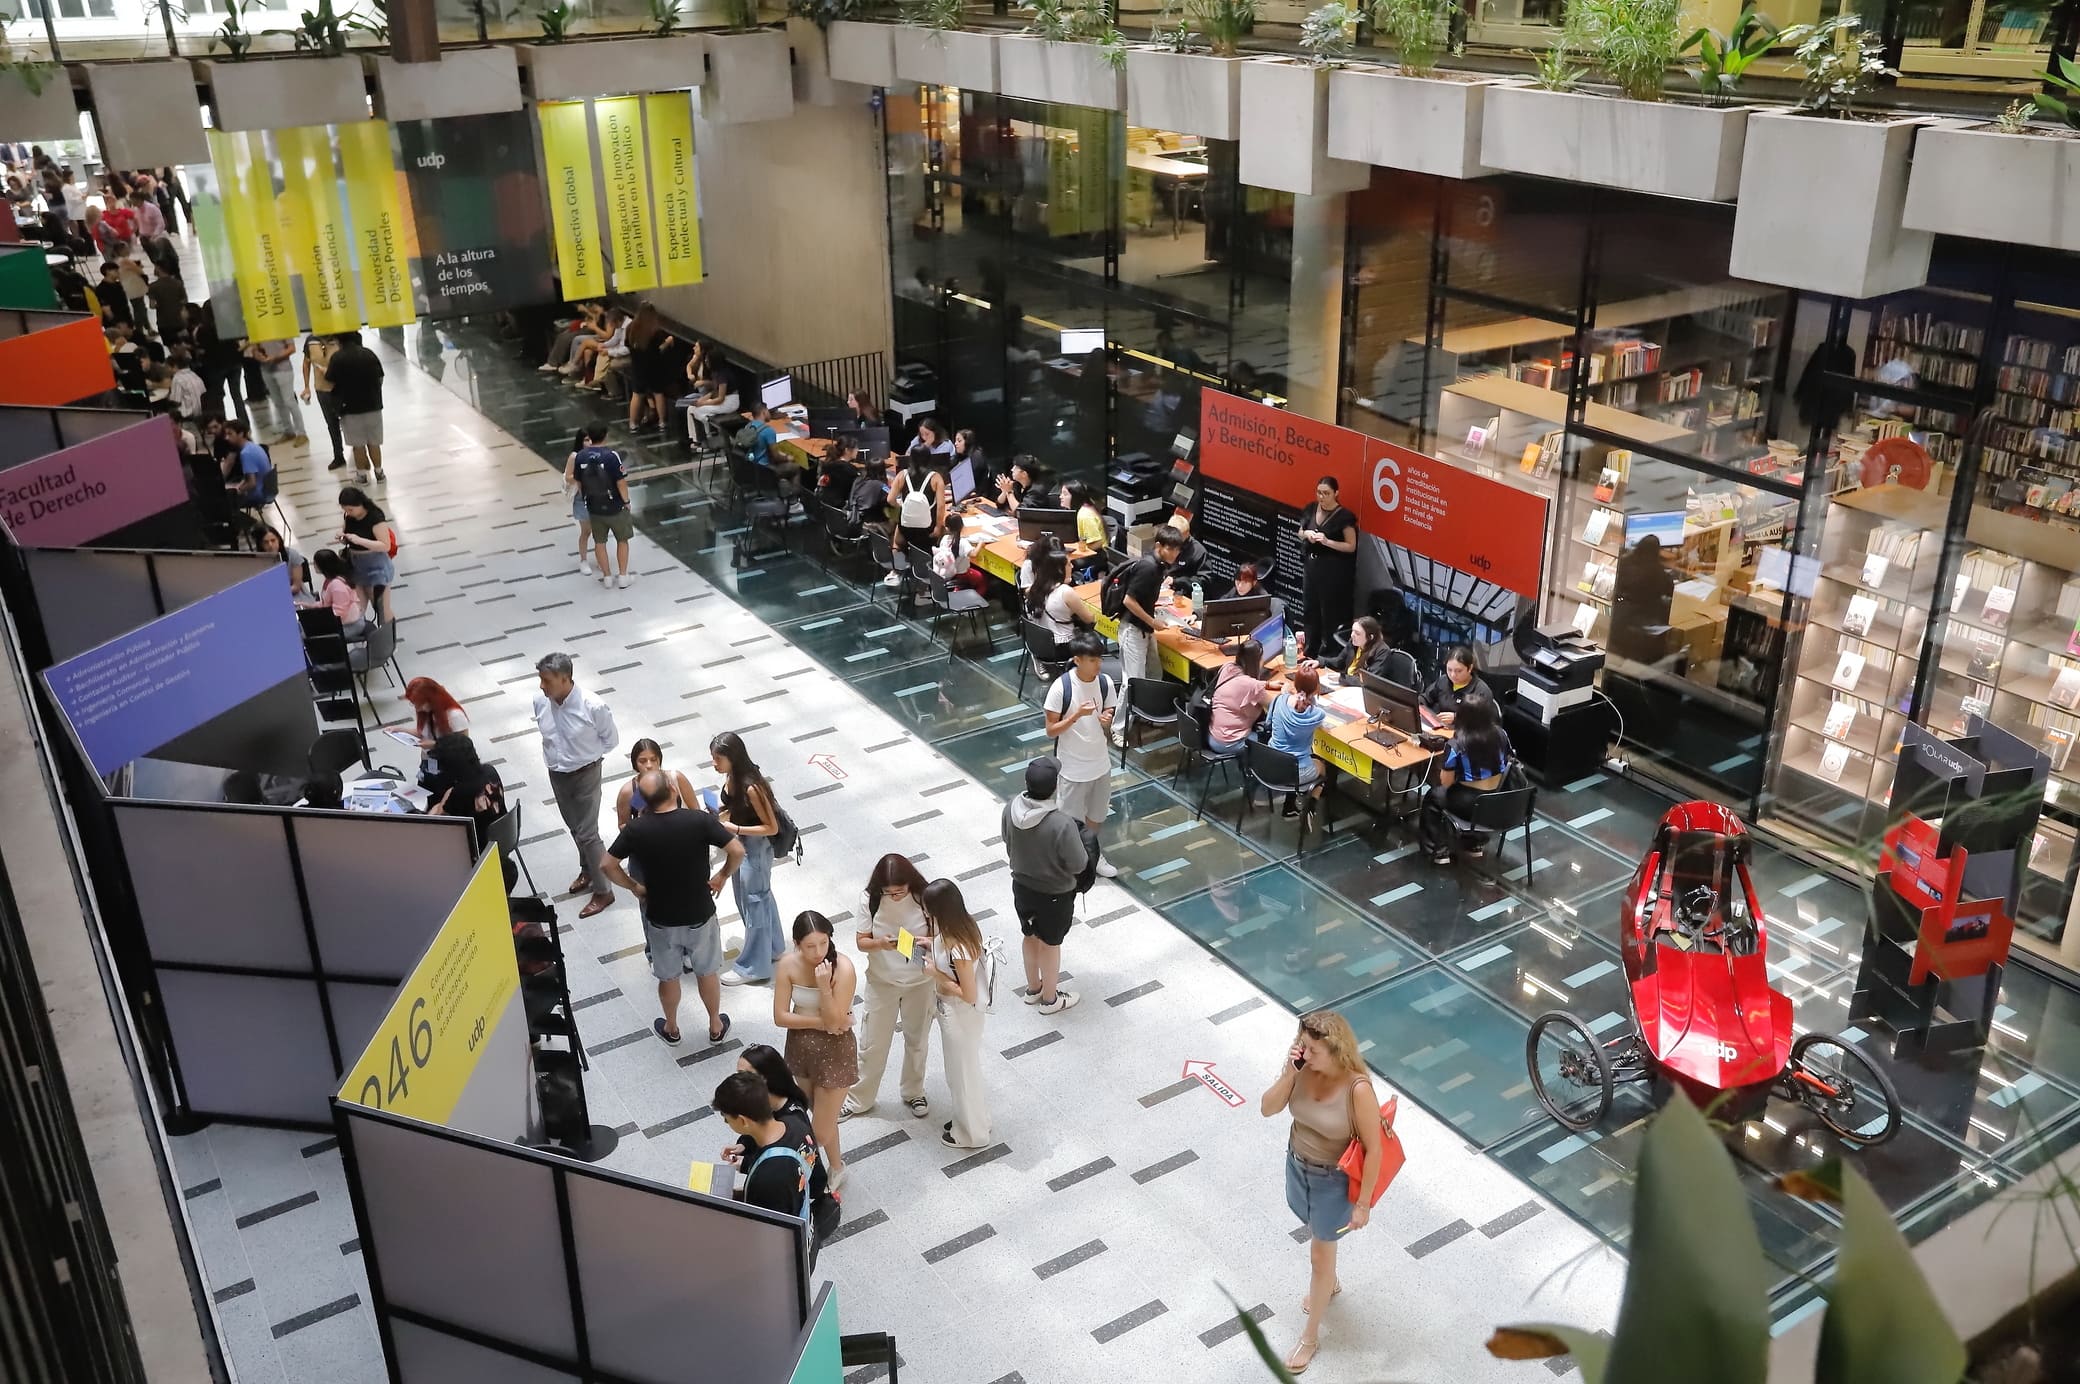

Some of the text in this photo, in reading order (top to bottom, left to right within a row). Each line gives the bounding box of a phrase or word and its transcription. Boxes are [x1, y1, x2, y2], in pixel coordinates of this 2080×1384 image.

[417, 152, 445, 169] udp
[608, 114, 634, 270] Investigación e Innovación
[623, 125, 648, 268] para Influir en lo Público
[672, 137, 691, 259] Intelectual y Cultural
[563, 165, 586, 278] Perspectiva Global
[664, 192, 680, 260] Experiencia
[261, 233, 285, 316] Universitaria
[325, 223, 347, 309] de Excelencia
[365, 229, 386, 305] Universidad
[380, 212, 402, 303] Diego Portales
[436, 249, 496, 266] A la altura
[438, 267, 473, 282] de los
[313, 245, 332, 311] Educación
[440, 281, 488, 296] tiempos
[253, 288, 269, 319] Vida
[1208, 427, 1295, 466] y Beneficios
[1209, 403, 1330, 456] Admisión, Becas
[1372, 457, 1401, 512] 6
[1406, 477, 1440, 493] acreditación
[1407, 466, 1429, 479] años de
[28, 481, 107, 521] Derecho
[1404, 505, 1434, 521] en nivel de
[1405, 485, 1448, 507] institucional en
[1405, 495, 1446, 516] todas las áreas
[1403, 514, 1433, 531] Excelencia
[1469, 553, 1491, 570] udp
[72, 650, 126, 680] Administración
[78, 684, 111, 703] Contador
[1321, 739, 1353, 766] Portales
[430, 938, 460, 989] Convenios
[433, 929, 476, 1006] internacionales
[444, 945, 479, 1010] cooperación
[468, 1015, 486, 1052] udp
[1202, 1074, 1234, 1100] SALIDA
